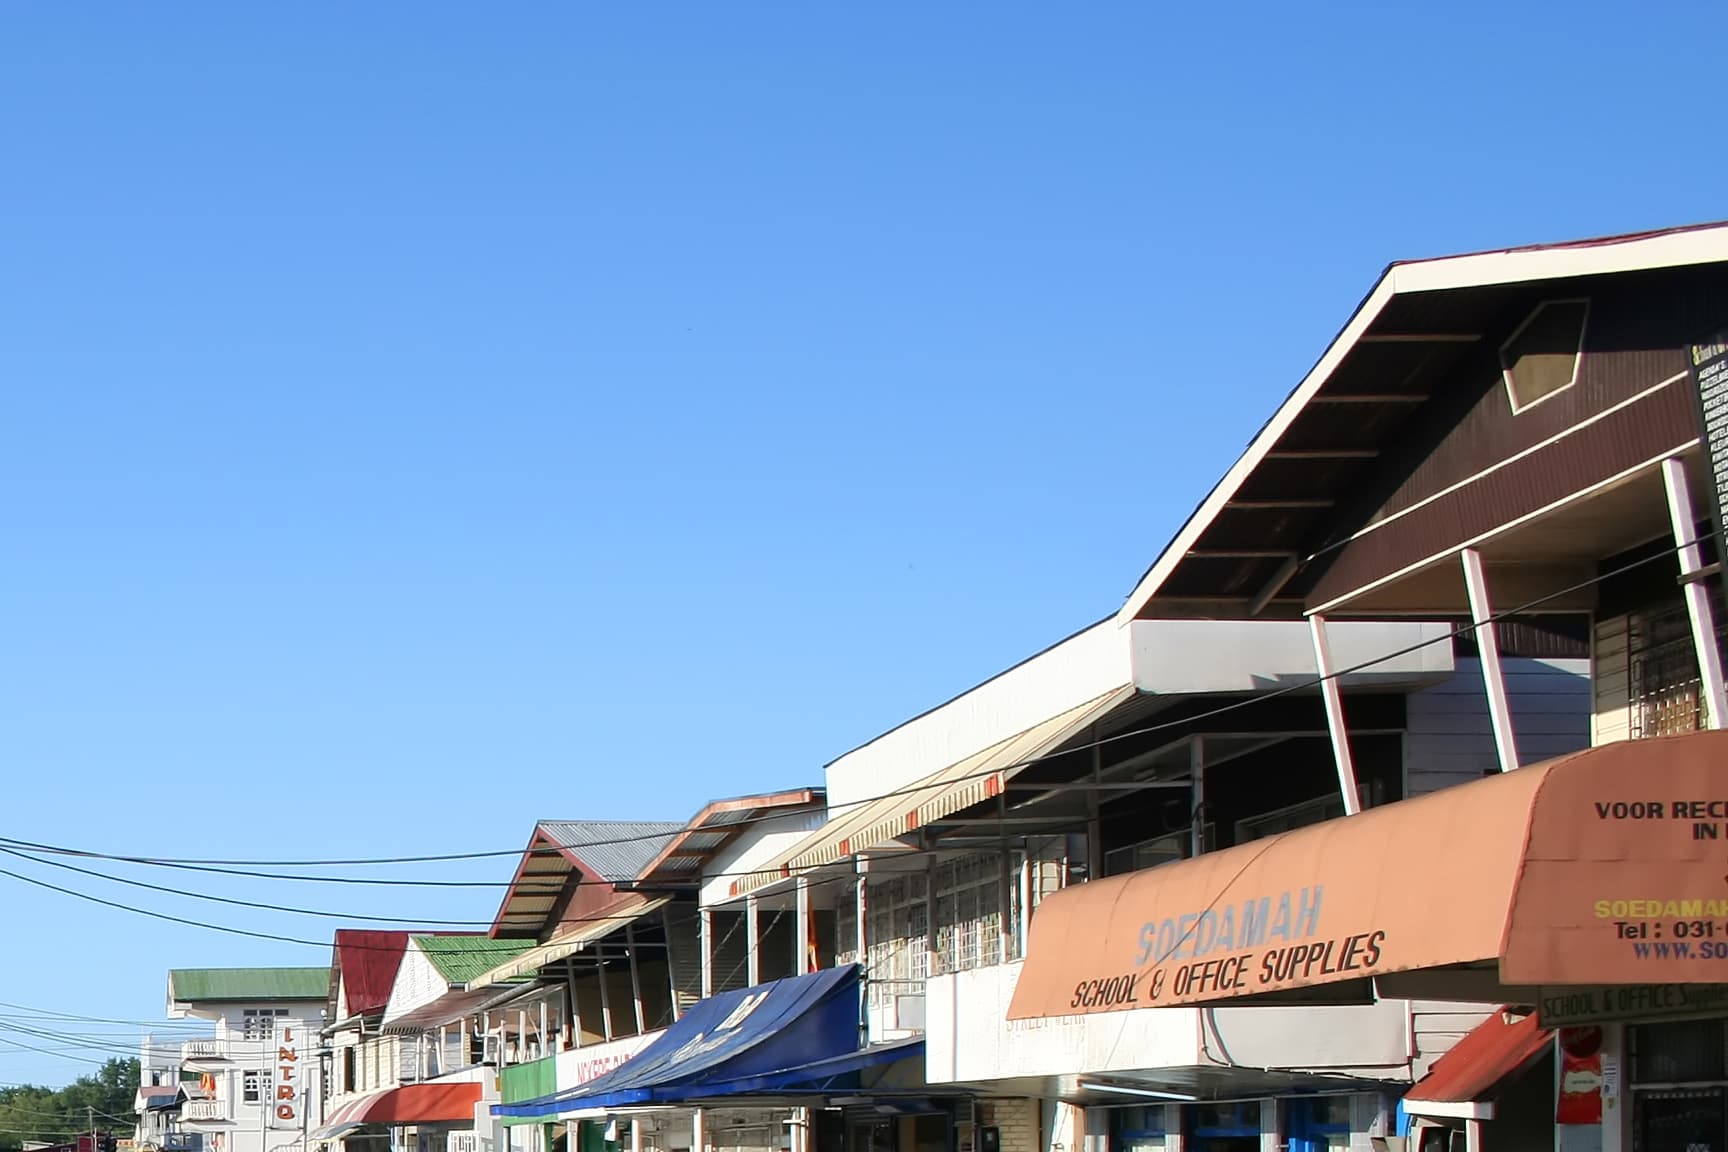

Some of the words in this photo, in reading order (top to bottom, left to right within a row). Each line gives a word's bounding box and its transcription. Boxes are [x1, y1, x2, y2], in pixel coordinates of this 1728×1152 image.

[1595, 802, 1663, 819] VOOR
[1693, 823, 1717, 840] IN
[1136, 884, 1324, 966] SOEDAMAH
[1614, 922, 1646, 939] Tel
[1673, 920, 1728, 939] 031-
[1071, 973, 1137, 1008] SCHOOL
[1149, 967, 1167, 1000] &
[1173, 954, 1253, 997] OFFICE
[1258, 930, 1385, 985] SUPPLIES
[1543, 992, 1598, 1018] SCHOOL
[1618, 984, 1673, 1010] OFFICE
[277, 1027, 297, 1120] INTRO
